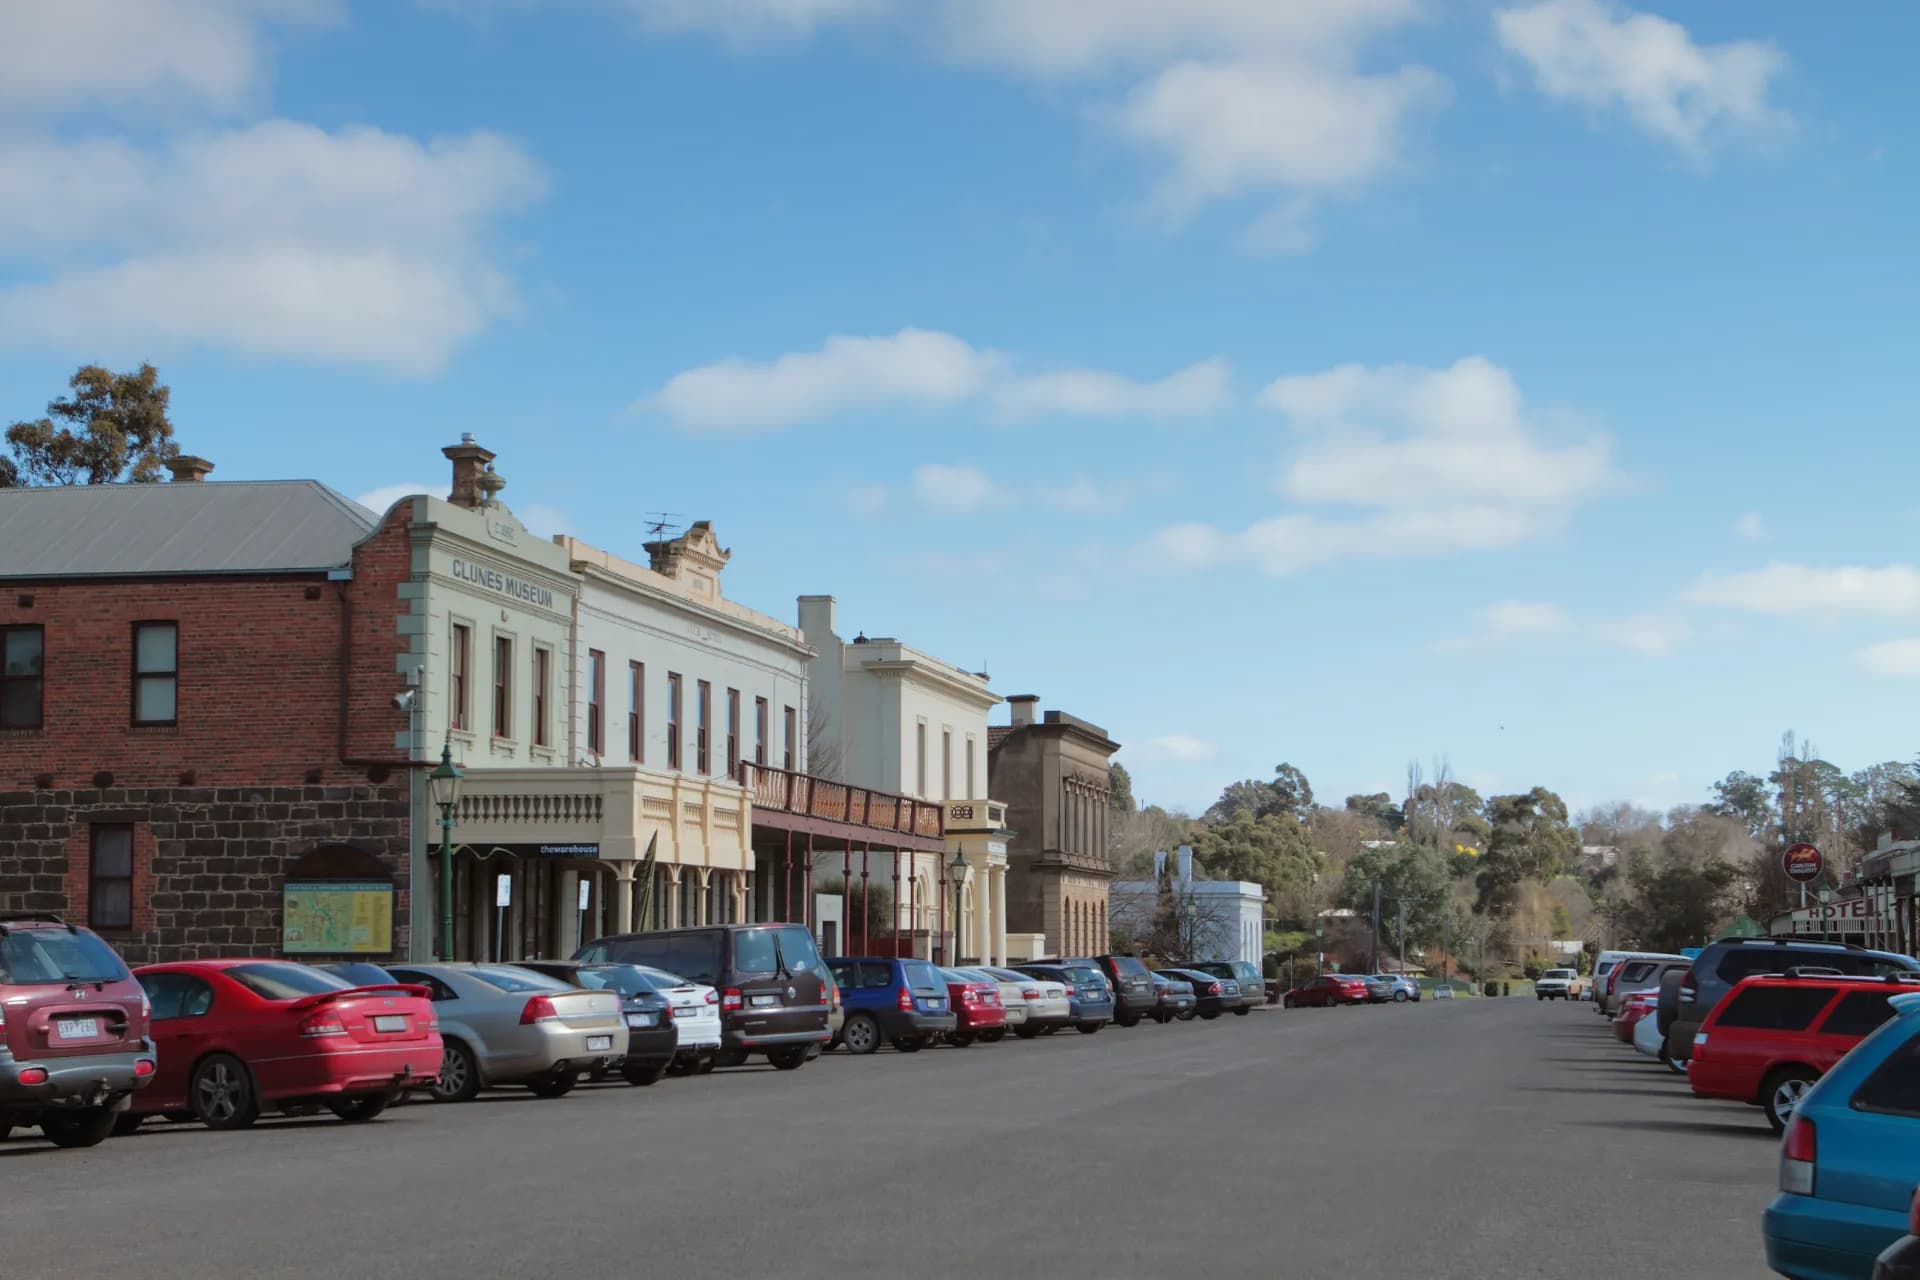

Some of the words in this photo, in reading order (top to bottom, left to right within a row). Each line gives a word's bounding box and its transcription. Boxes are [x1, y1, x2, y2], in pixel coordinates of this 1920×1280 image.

[452, 559, 503, 591] CLUNES
[504, 576, 553, 608] MUSEUM
[1809, 899, 1882, 918] HOTEL
